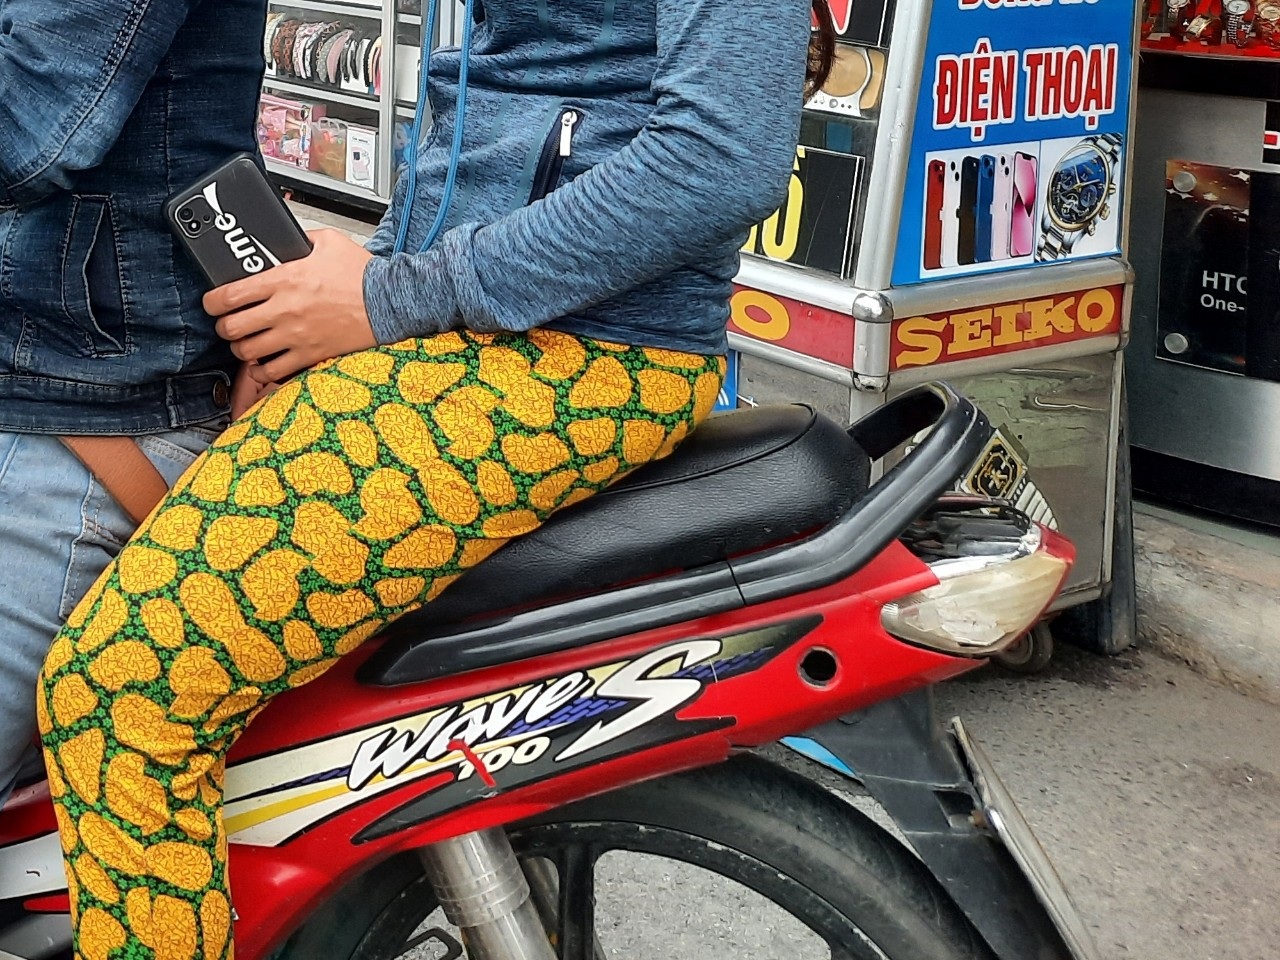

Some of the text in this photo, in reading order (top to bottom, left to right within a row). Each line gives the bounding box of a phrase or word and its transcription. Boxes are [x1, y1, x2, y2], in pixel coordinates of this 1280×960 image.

[934, 38, 1118, 140] ĐIỆN THOẠI
[214, 211, 265, 273] eme
[897, 288, 1115, 368] SEIKO
[346, 639, 722, 790] Wave S
